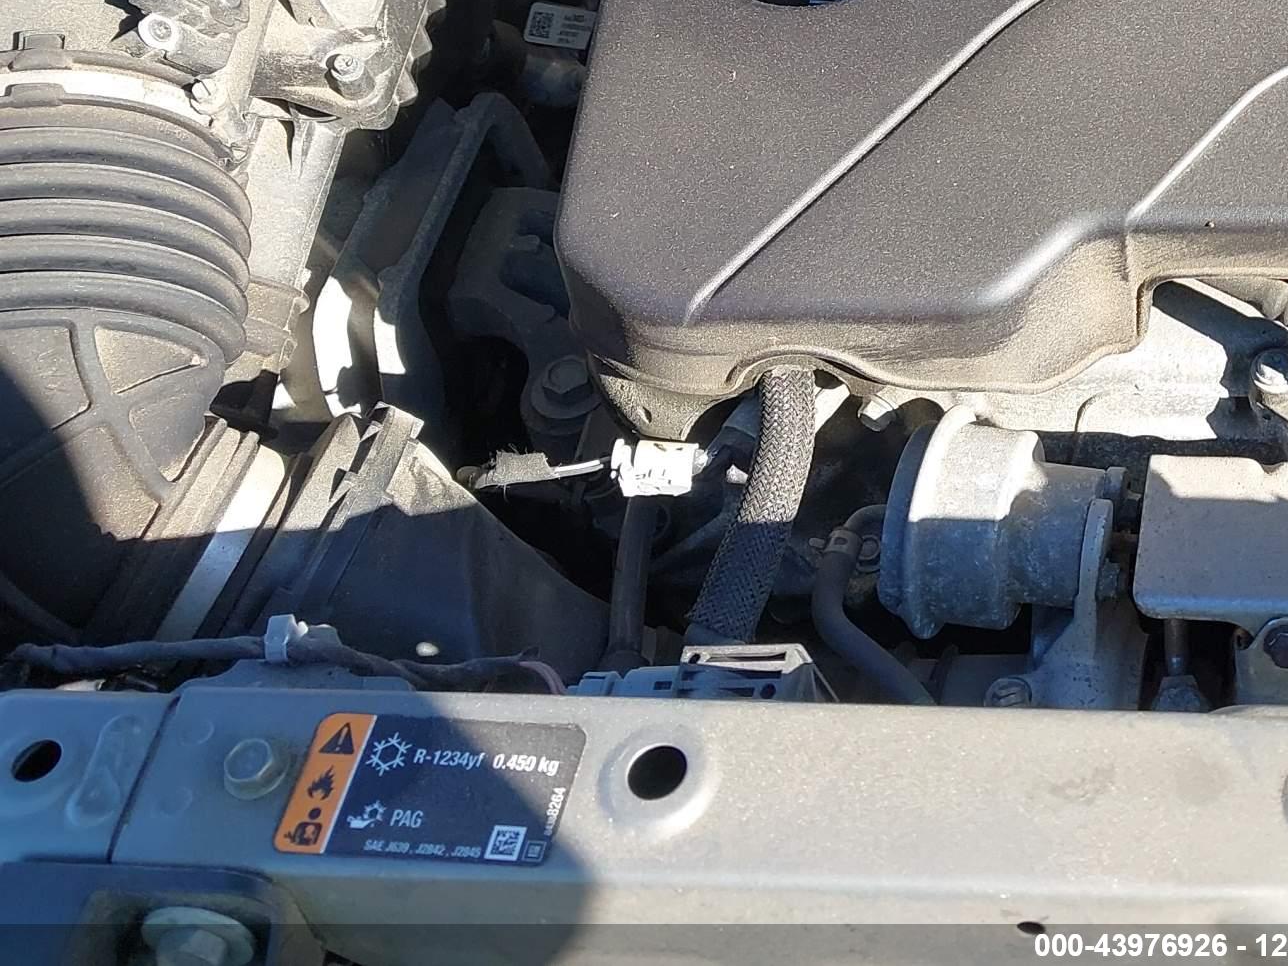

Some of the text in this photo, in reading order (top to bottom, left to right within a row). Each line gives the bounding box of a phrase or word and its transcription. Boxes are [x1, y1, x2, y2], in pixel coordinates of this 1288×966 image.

[413, 748, 560, 777] R-1234yf 0.450 kg
[390, 809, 424, 828] PAG
